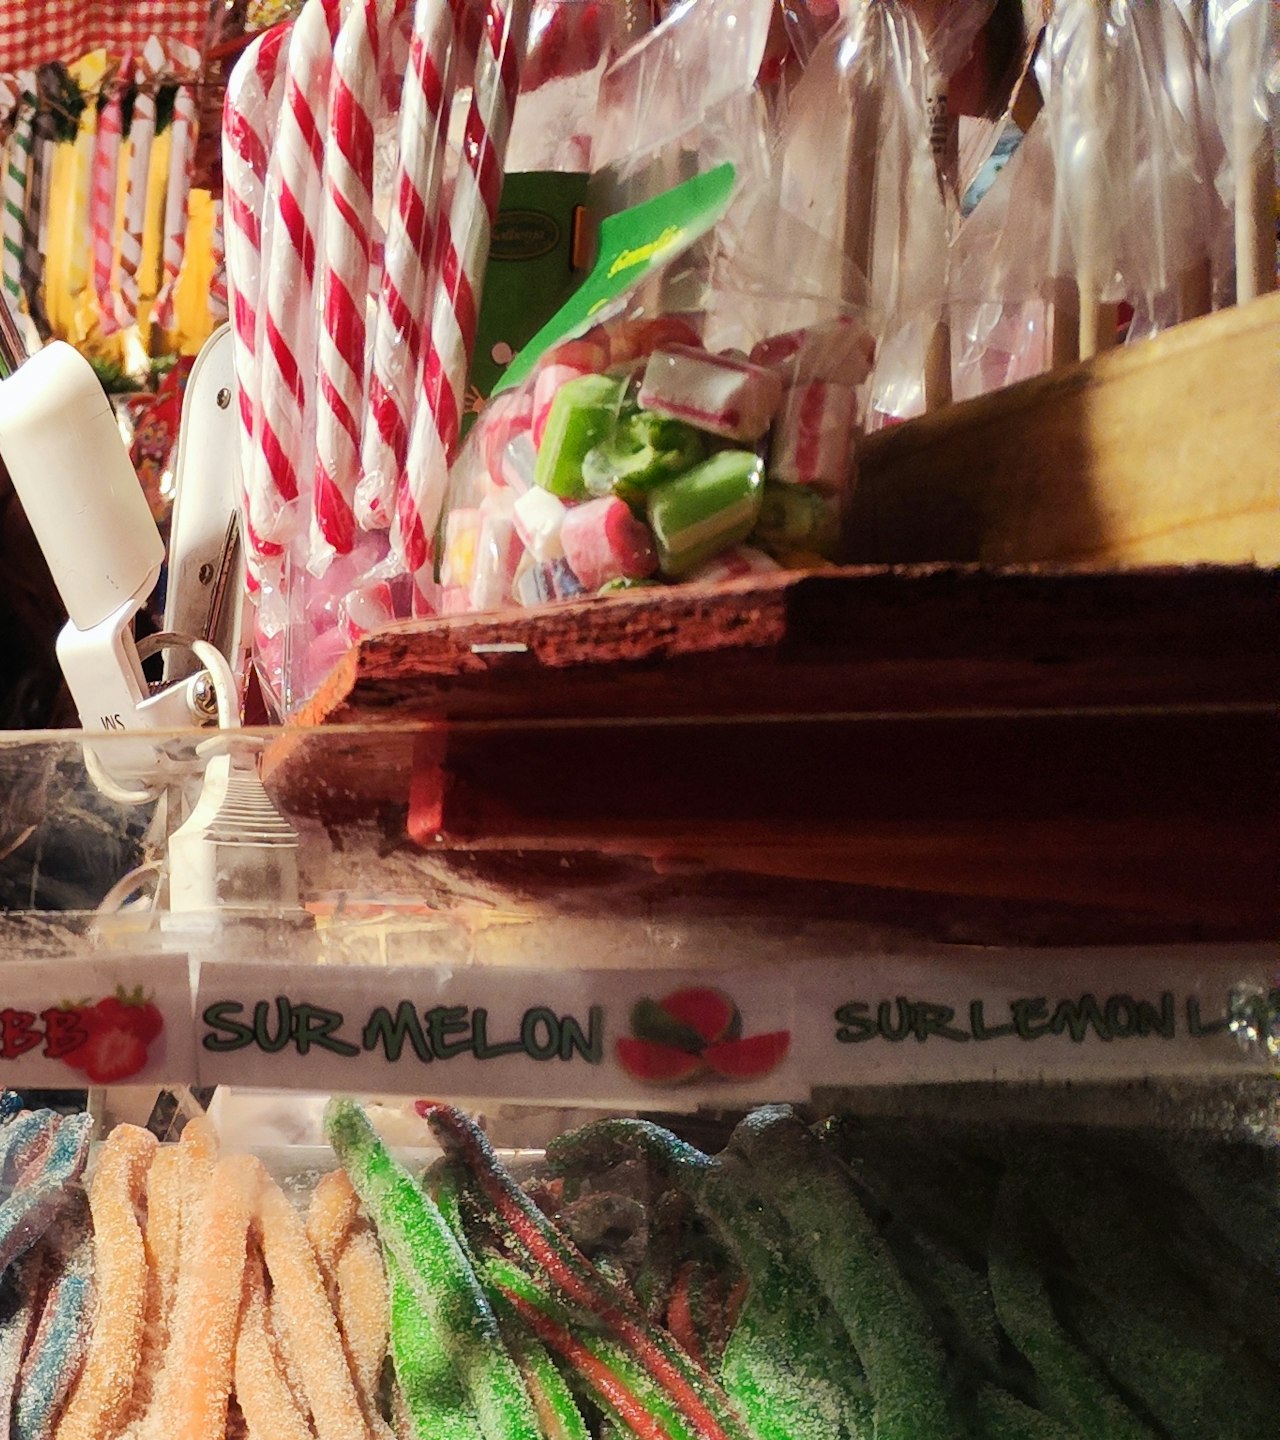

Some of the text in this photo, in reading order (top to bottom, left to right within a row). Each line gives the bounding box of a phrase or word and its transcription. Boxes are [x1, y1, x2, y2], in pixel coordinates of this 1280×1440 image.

[200, 996, 605, 1065] SUR MELON
[835, 996, 970, 1043] SUR
[968, 990, 1175, 1043] LEMON
